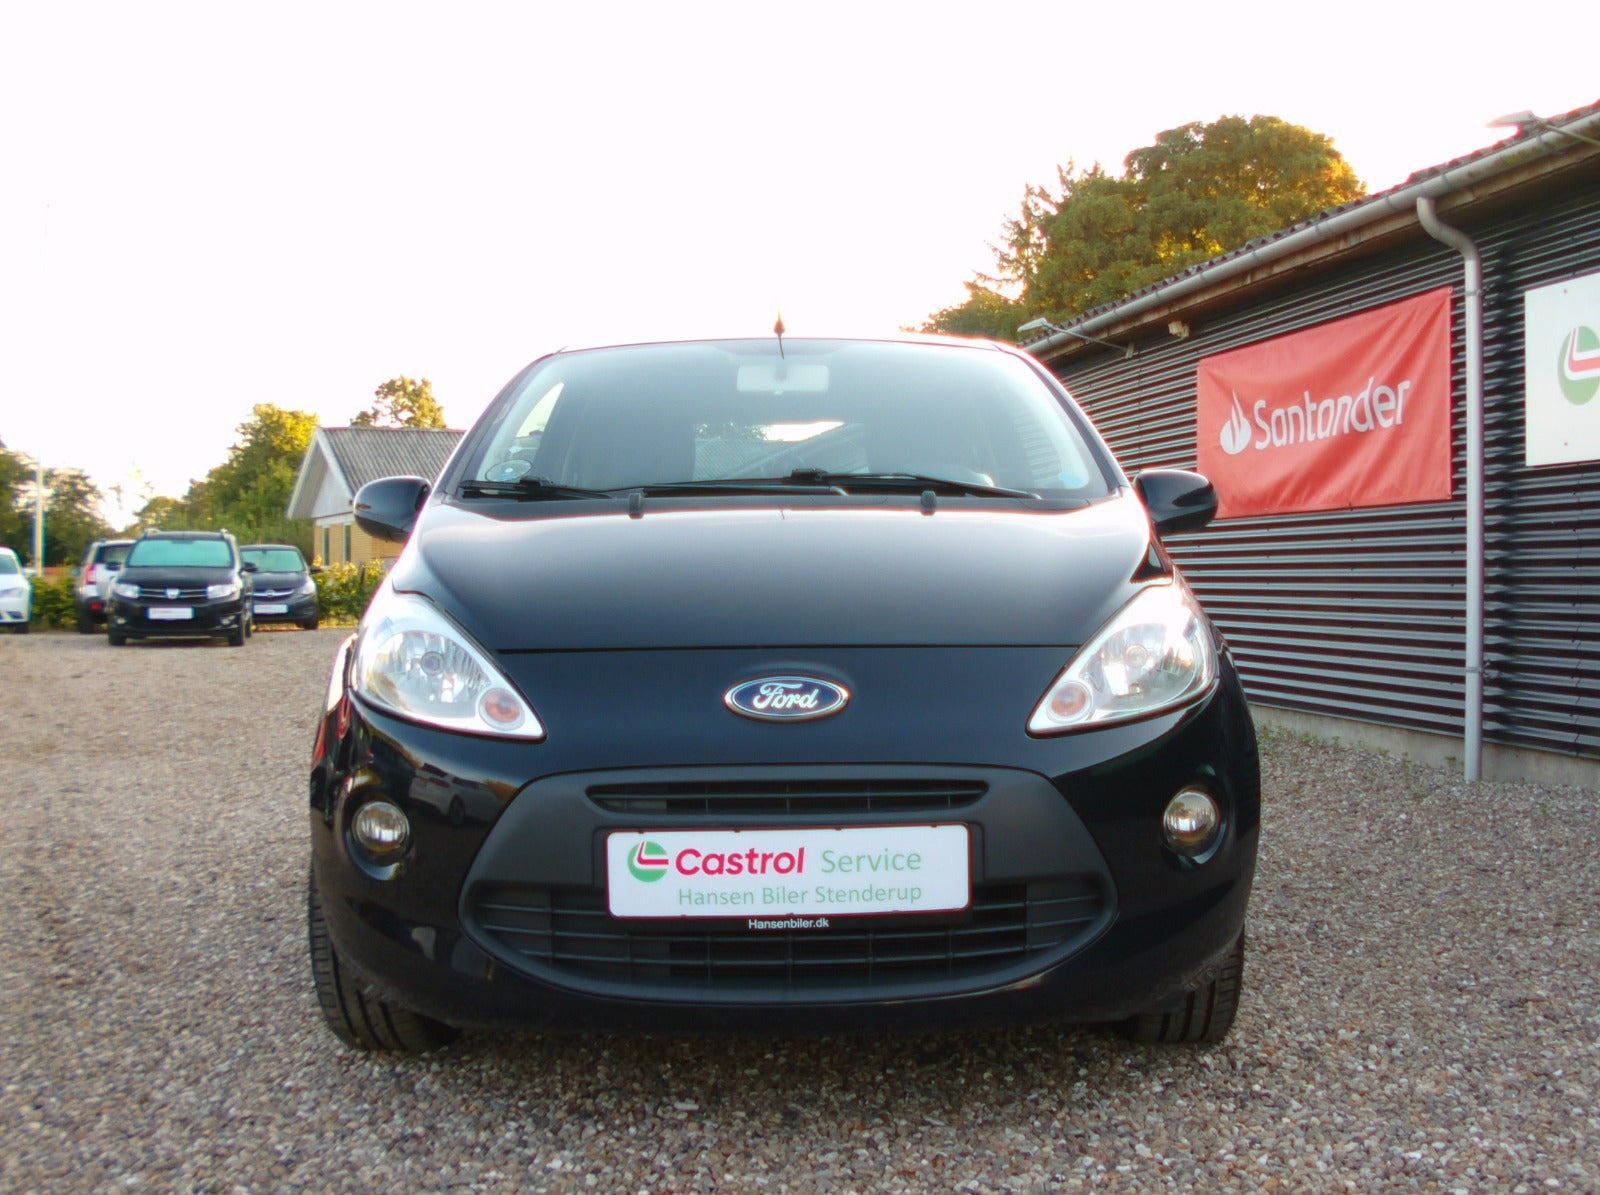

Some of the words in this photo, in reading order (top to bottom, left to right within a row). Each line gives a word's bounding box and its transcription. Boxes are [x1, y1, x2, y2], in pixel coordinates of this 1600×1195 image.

[1254, 376, 1410, 450] Santander
[753, 682, 819, 709] Ford
[675, 846, 806, 876] Castrol
[821, 848, 922, 874] Service
[678, 887, 754, 906] Hansen
[762, 885, 808, 905] Biler
[815, 884, 922, 904] Stenderup
[748, 917, 830, 930] Hansenbiler.dk
